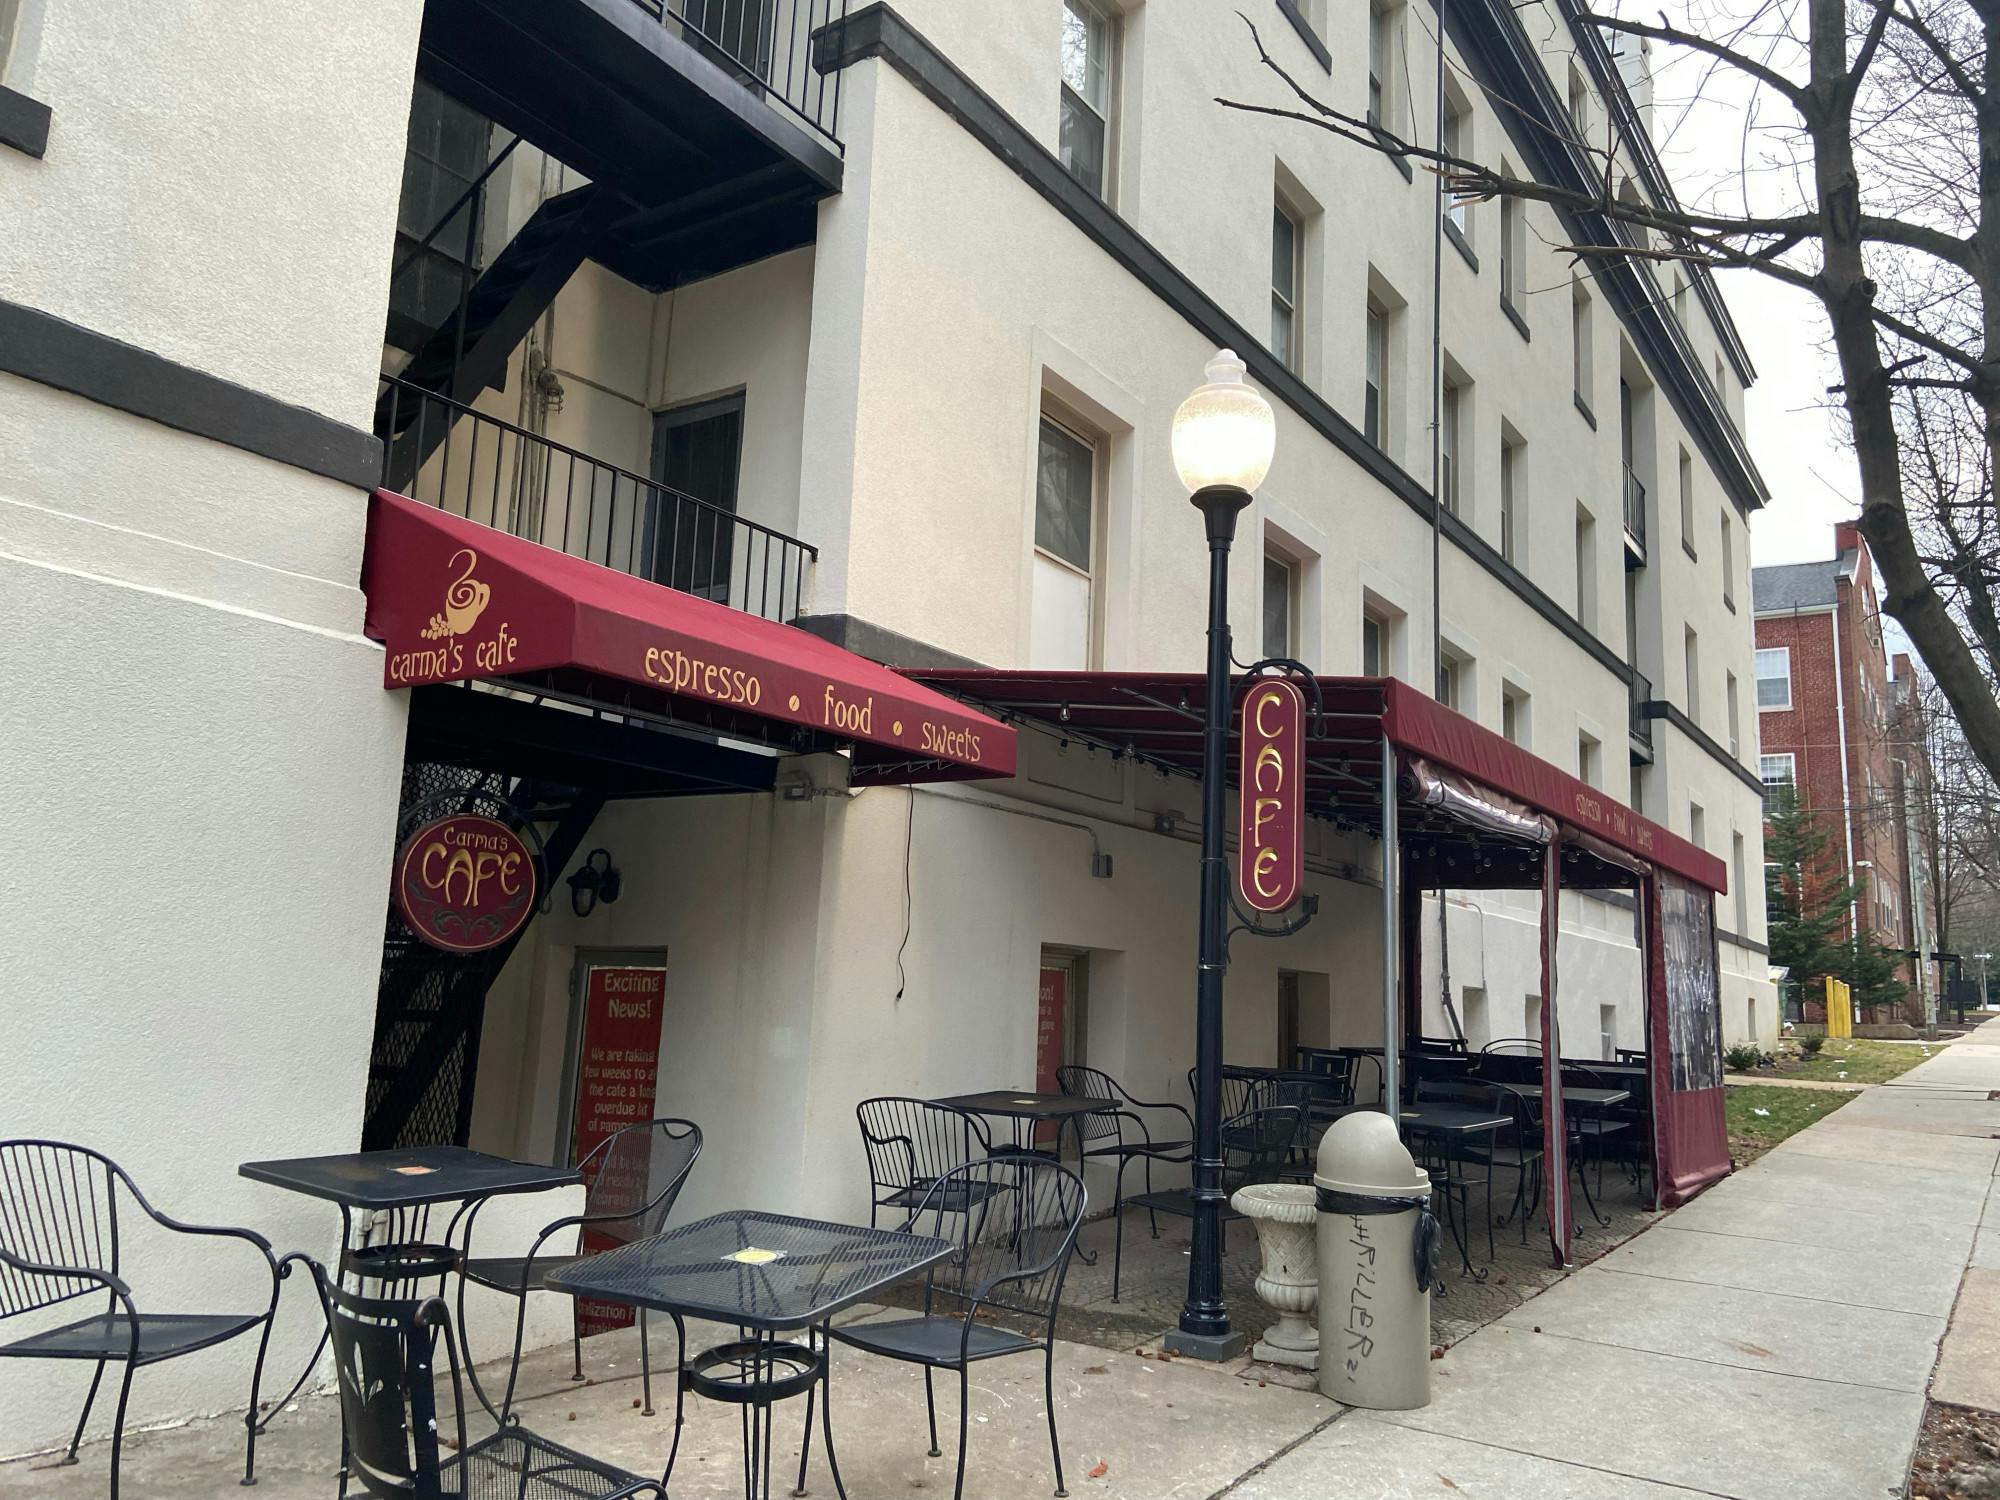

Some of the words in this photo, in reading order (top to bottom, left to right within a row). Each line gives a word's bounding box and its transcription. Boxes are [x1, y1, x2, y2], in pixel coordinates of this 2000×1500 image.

[390, 638, 463, 682] carma's
[476, 622, 518, 671] cafe
[645, 647, 761, 706] espresso
[824, 685, 872, 734] food
[921, 722, 981, 762] sweets
[1254, 692, 1283, 897] CAFE
[444, 826, 508, 851] Carma's
[422, 842, 521, 907] CAFE
[604, 972, 660, 993] Exciting
[608, 999, 652, 1018] News!
[591, 1048, 605, 1061] We
[607, 1050, 623, 1062] are
[602, 1066, 632, 1080] weeks
[635, 1067, 647, 1080] to
[606, 1084, 627, 1098] cafe
[629, 1086, 636, 1098] a
[594, 1100, 636, 1116] overdue
[588, 1118, 599, 1132] of
